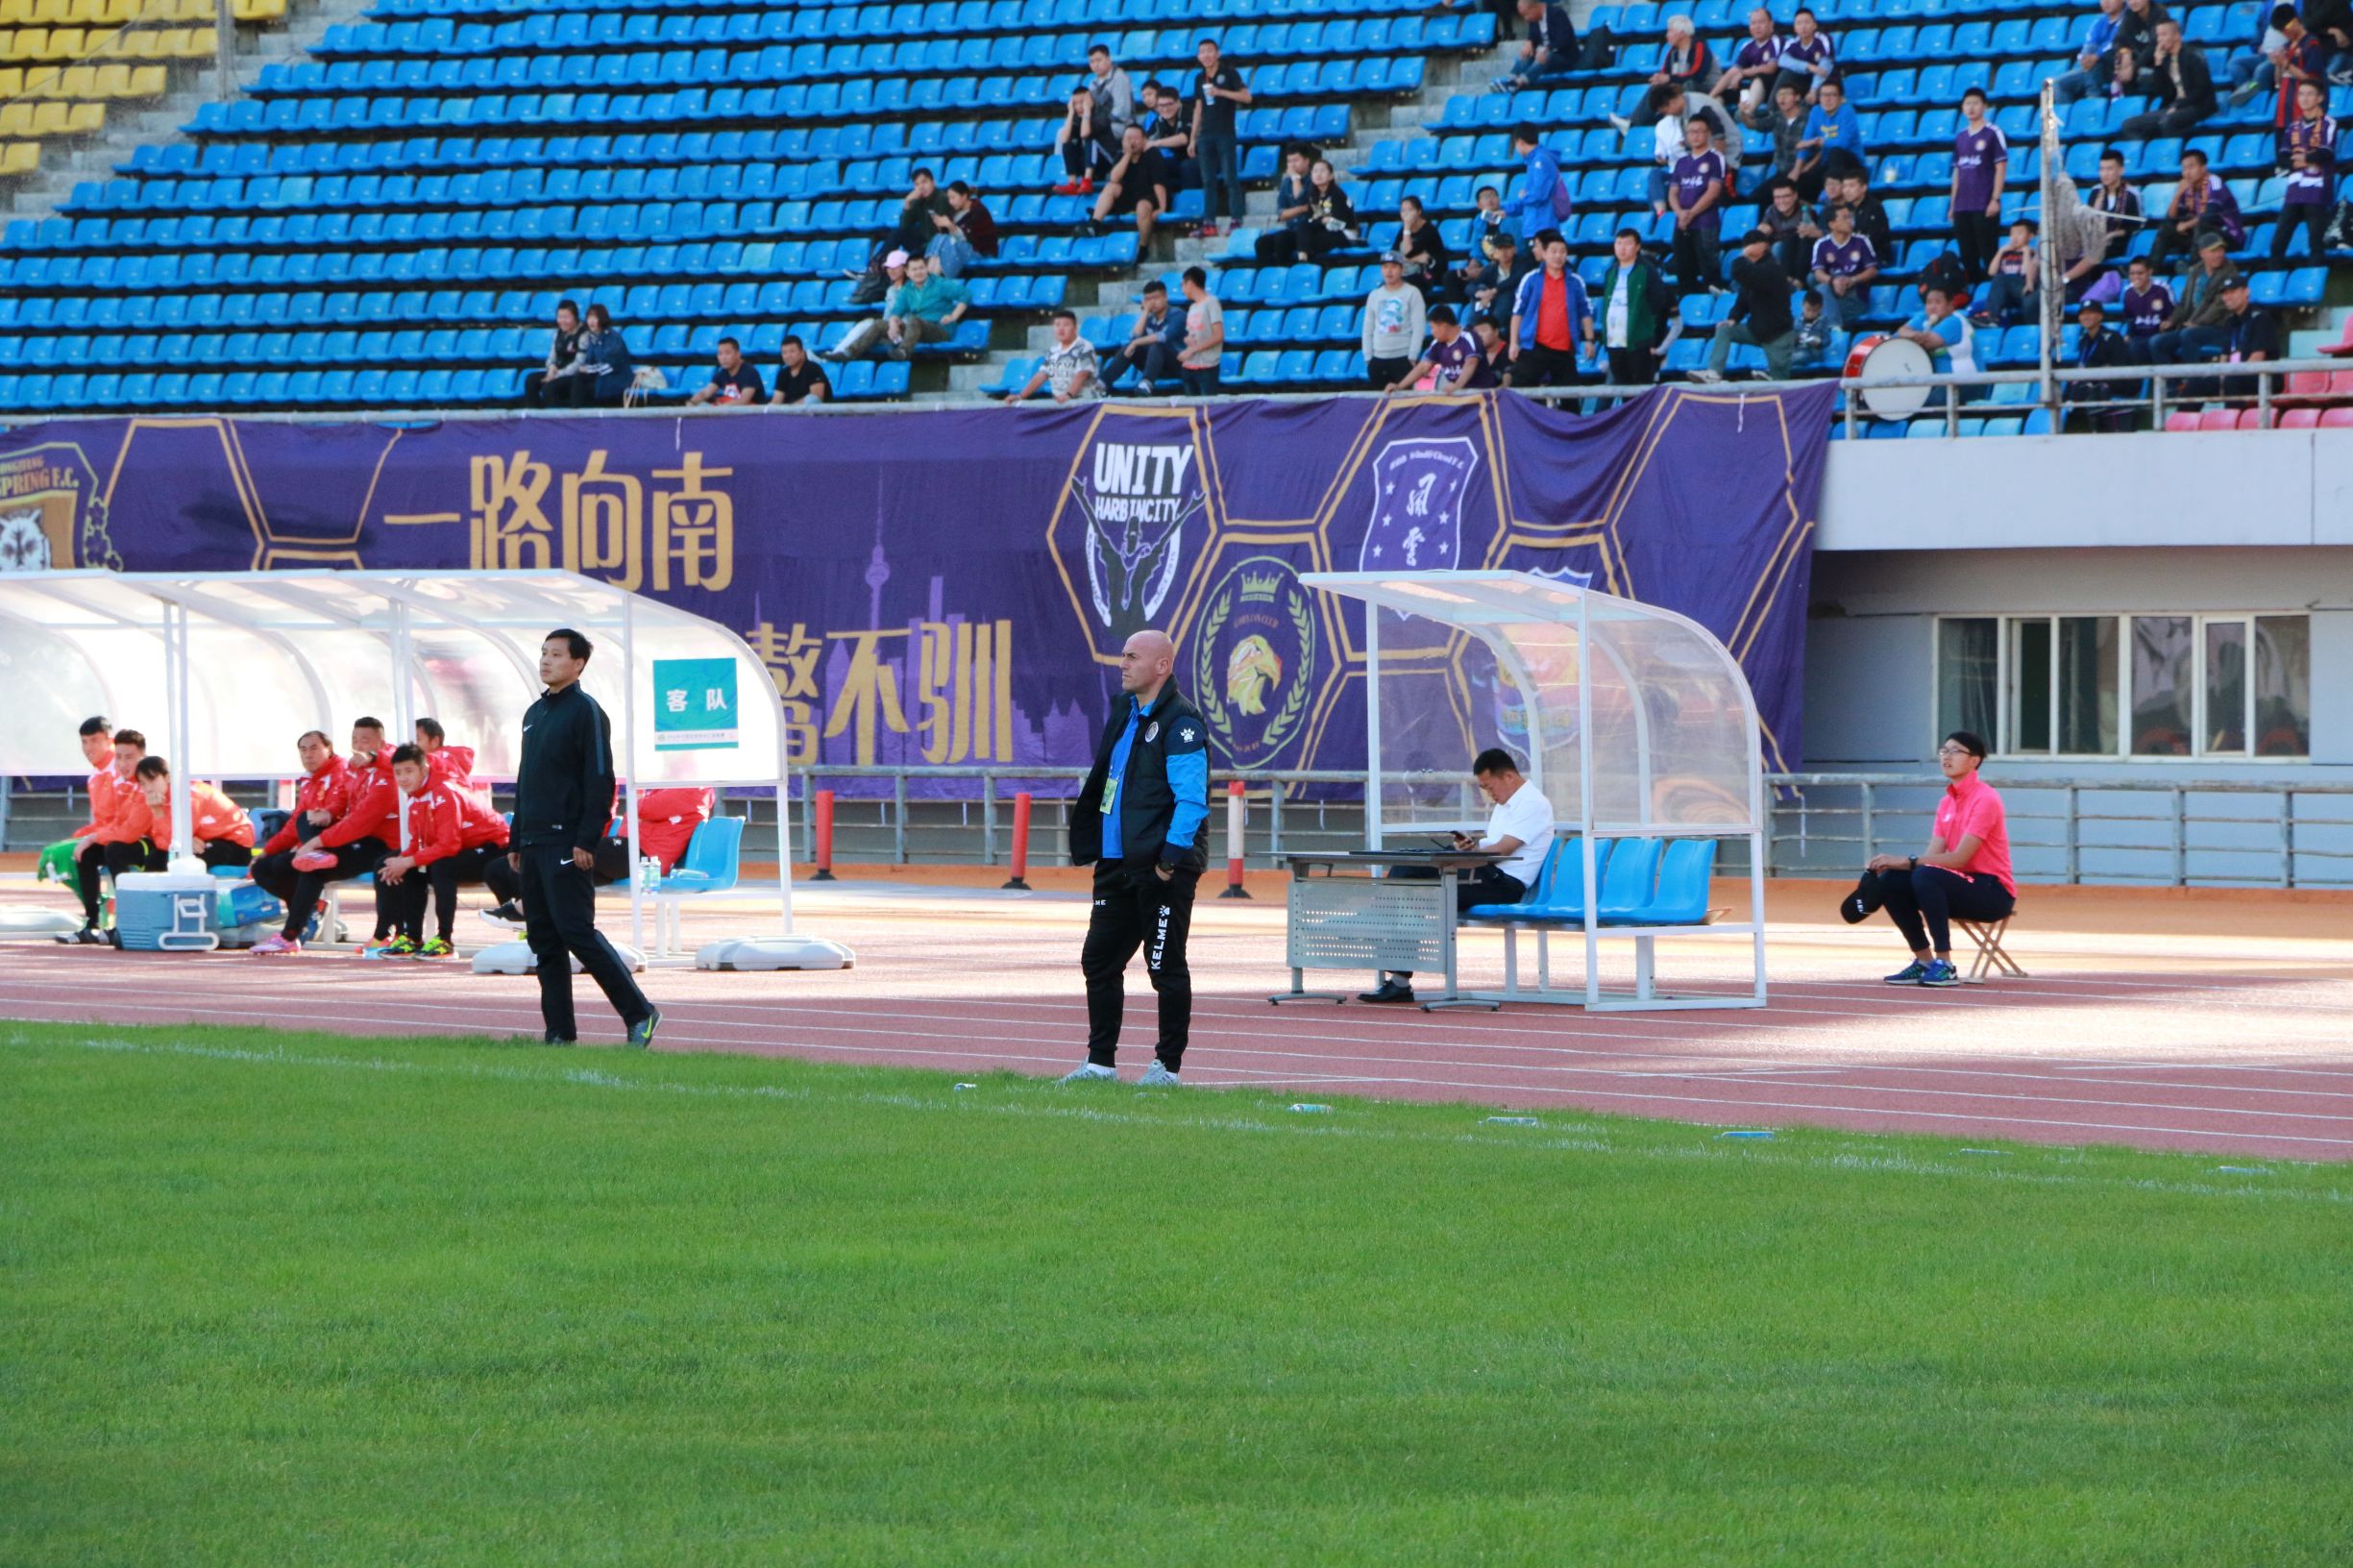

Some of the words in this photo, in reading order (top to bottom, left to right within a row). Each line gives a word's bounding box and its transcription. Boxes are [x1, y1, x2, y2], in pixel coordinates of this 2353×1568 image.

[0, 467, 50, 498] PRING
[1093, 442, 1194, 495] UNITY
[383, 449, 734, 592] 一路向南
[666, 687, 728, 713] 客队
[1150, 918, 1168, 970] KELME
